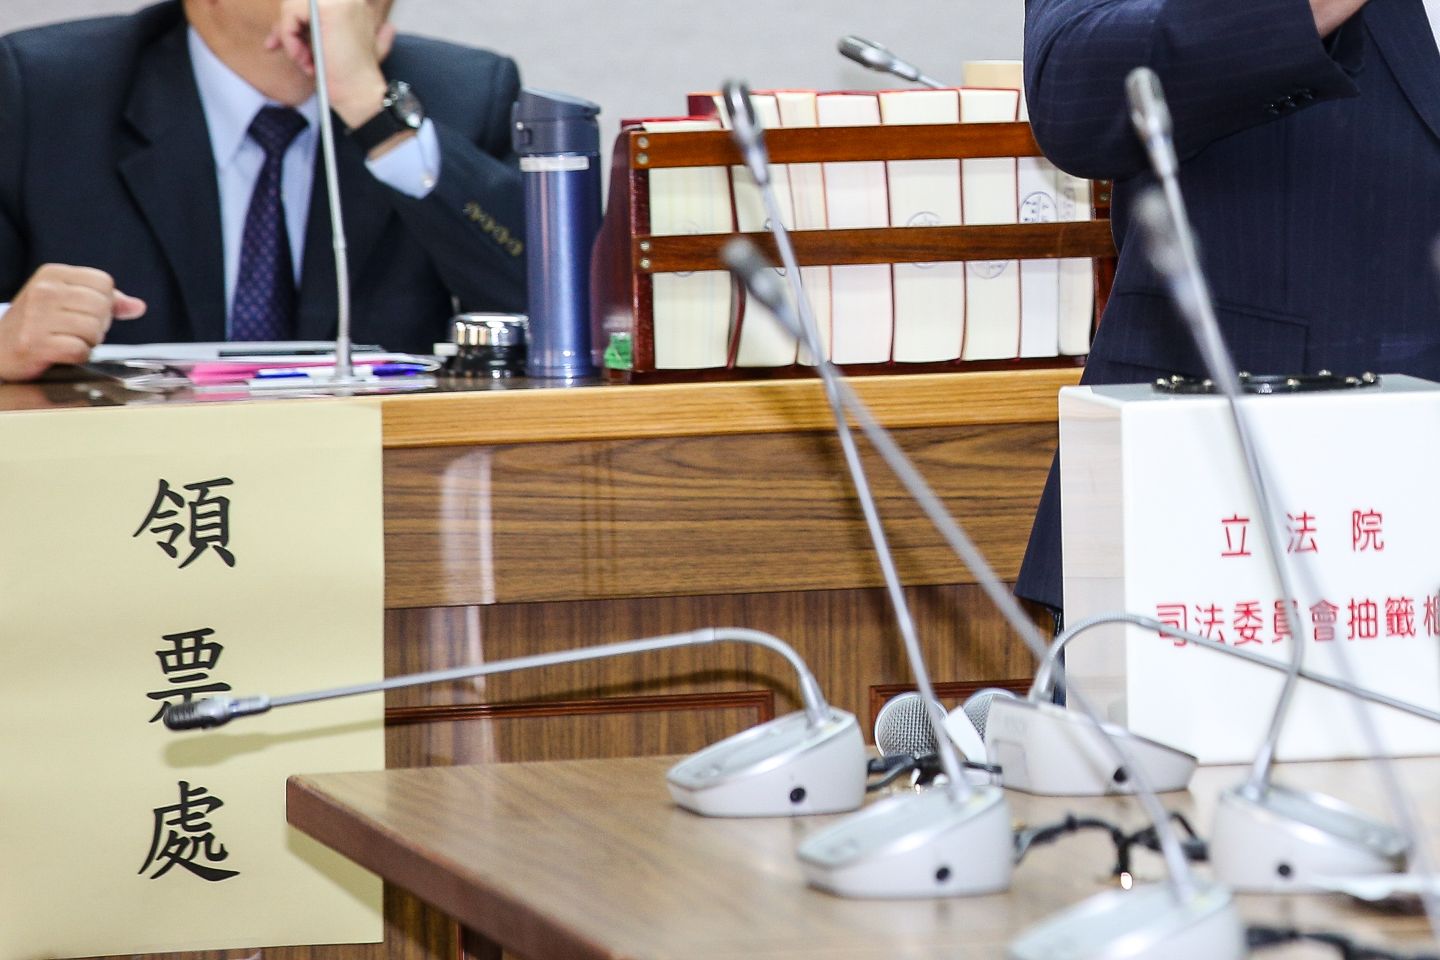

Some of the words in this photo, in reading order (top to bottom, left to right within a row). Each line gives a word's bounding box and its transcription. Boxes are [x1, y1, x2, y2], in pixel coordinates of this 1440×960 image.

[1221, 509, 1384, 557] 立法院
[133, 477, 240, 882] 領票處
